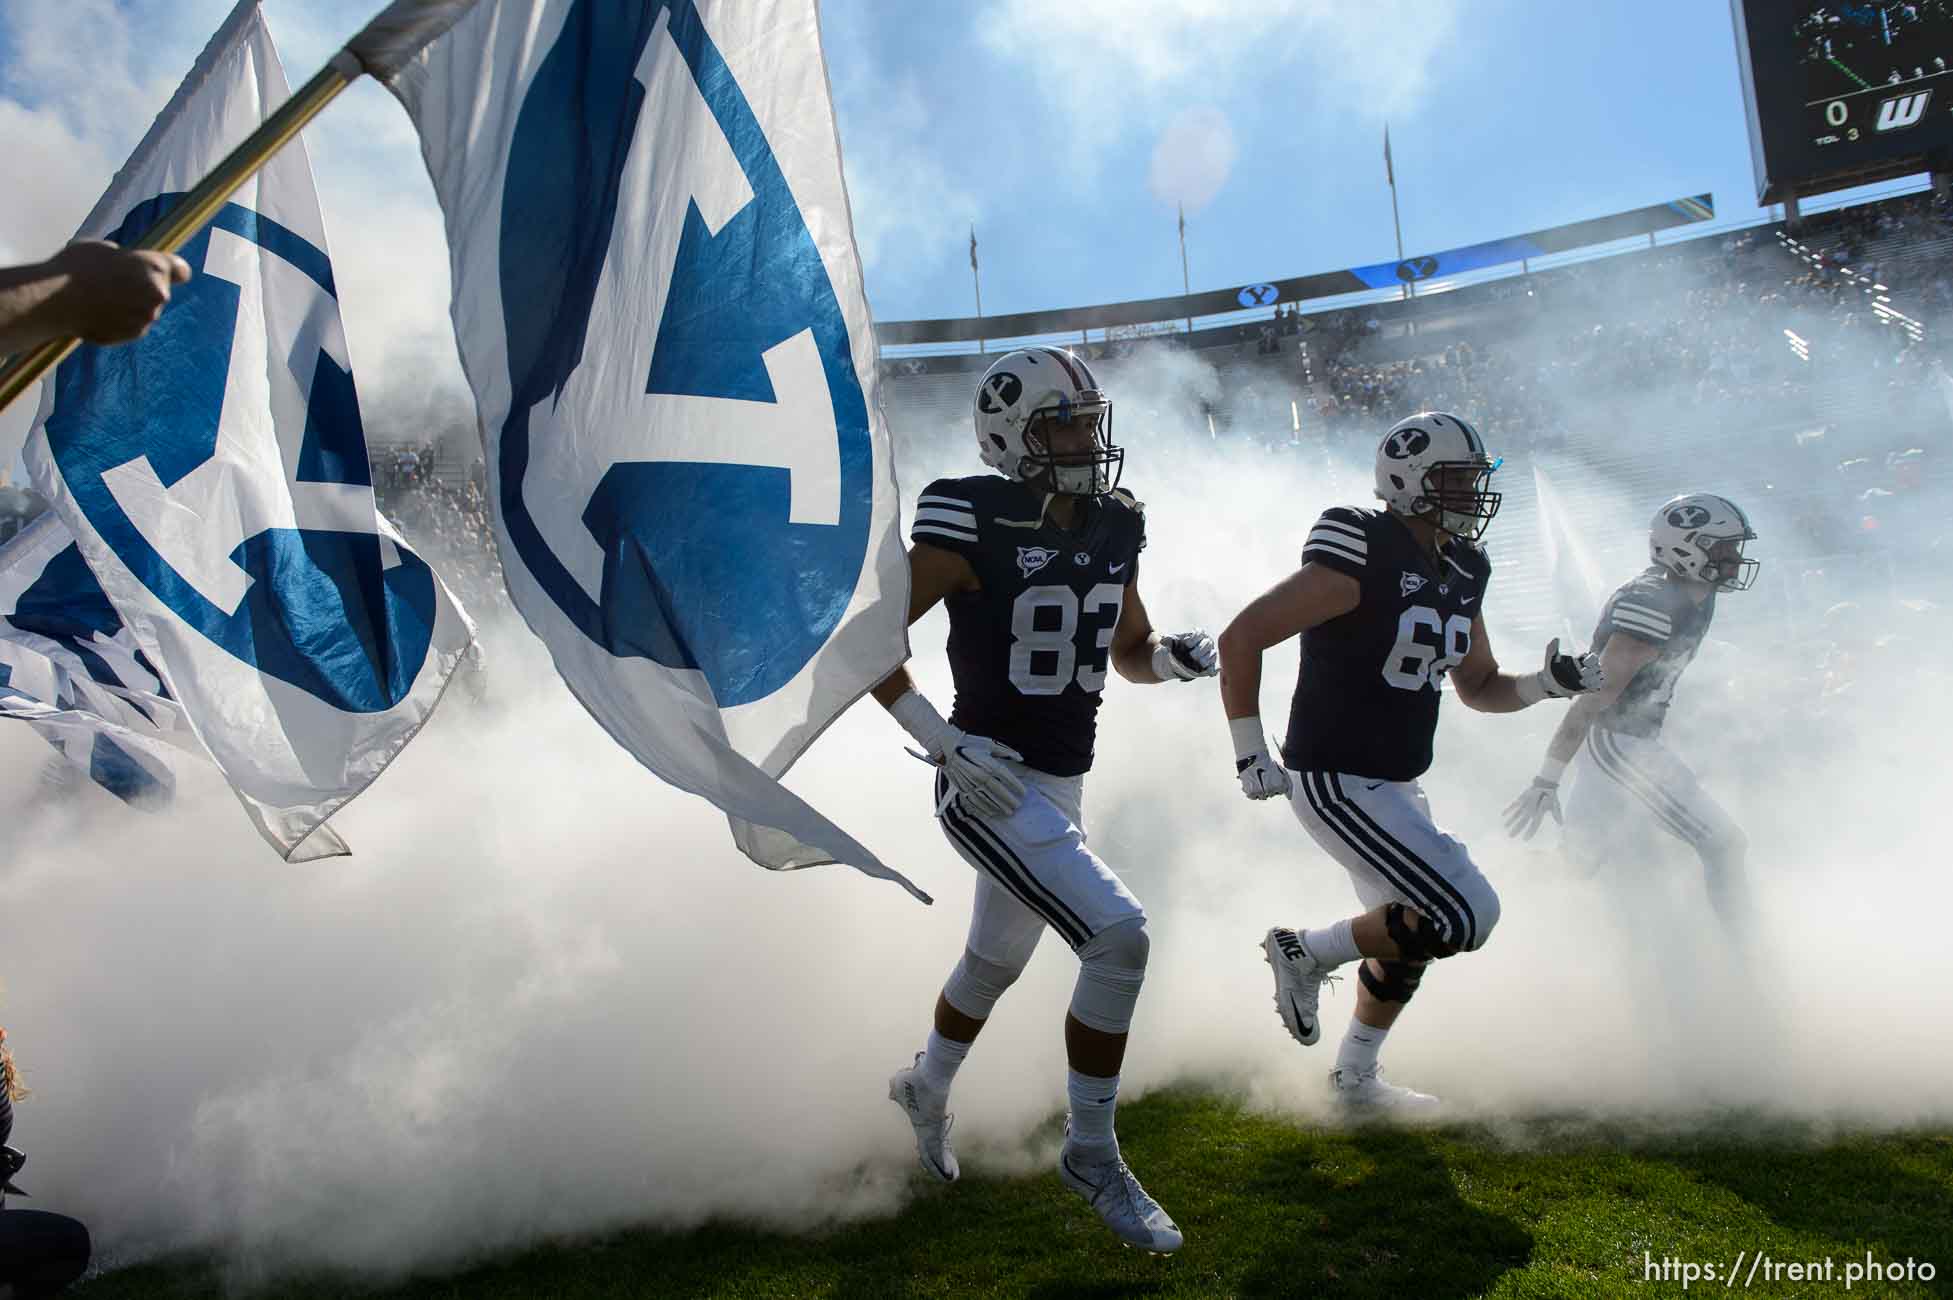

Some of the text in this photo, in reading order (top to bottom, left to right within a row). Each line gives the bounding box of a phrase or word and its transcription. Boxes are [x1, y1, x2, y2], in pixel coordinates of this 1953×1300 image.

[1847, 127, 1860, 141] 3
[1243, 285, 1272, 306] Y
[982, 374, 1014, 412] Y
[1390, 430, 1423, 457] Y
[1024, 556, 1044, 565] NCAA
[1075, 553, 1089, 565] Y
[1008, 583, 1125, 695] 83
[1382, 604, 1472, 692] 68
[1272, 928, 1306, 961] NIKE
